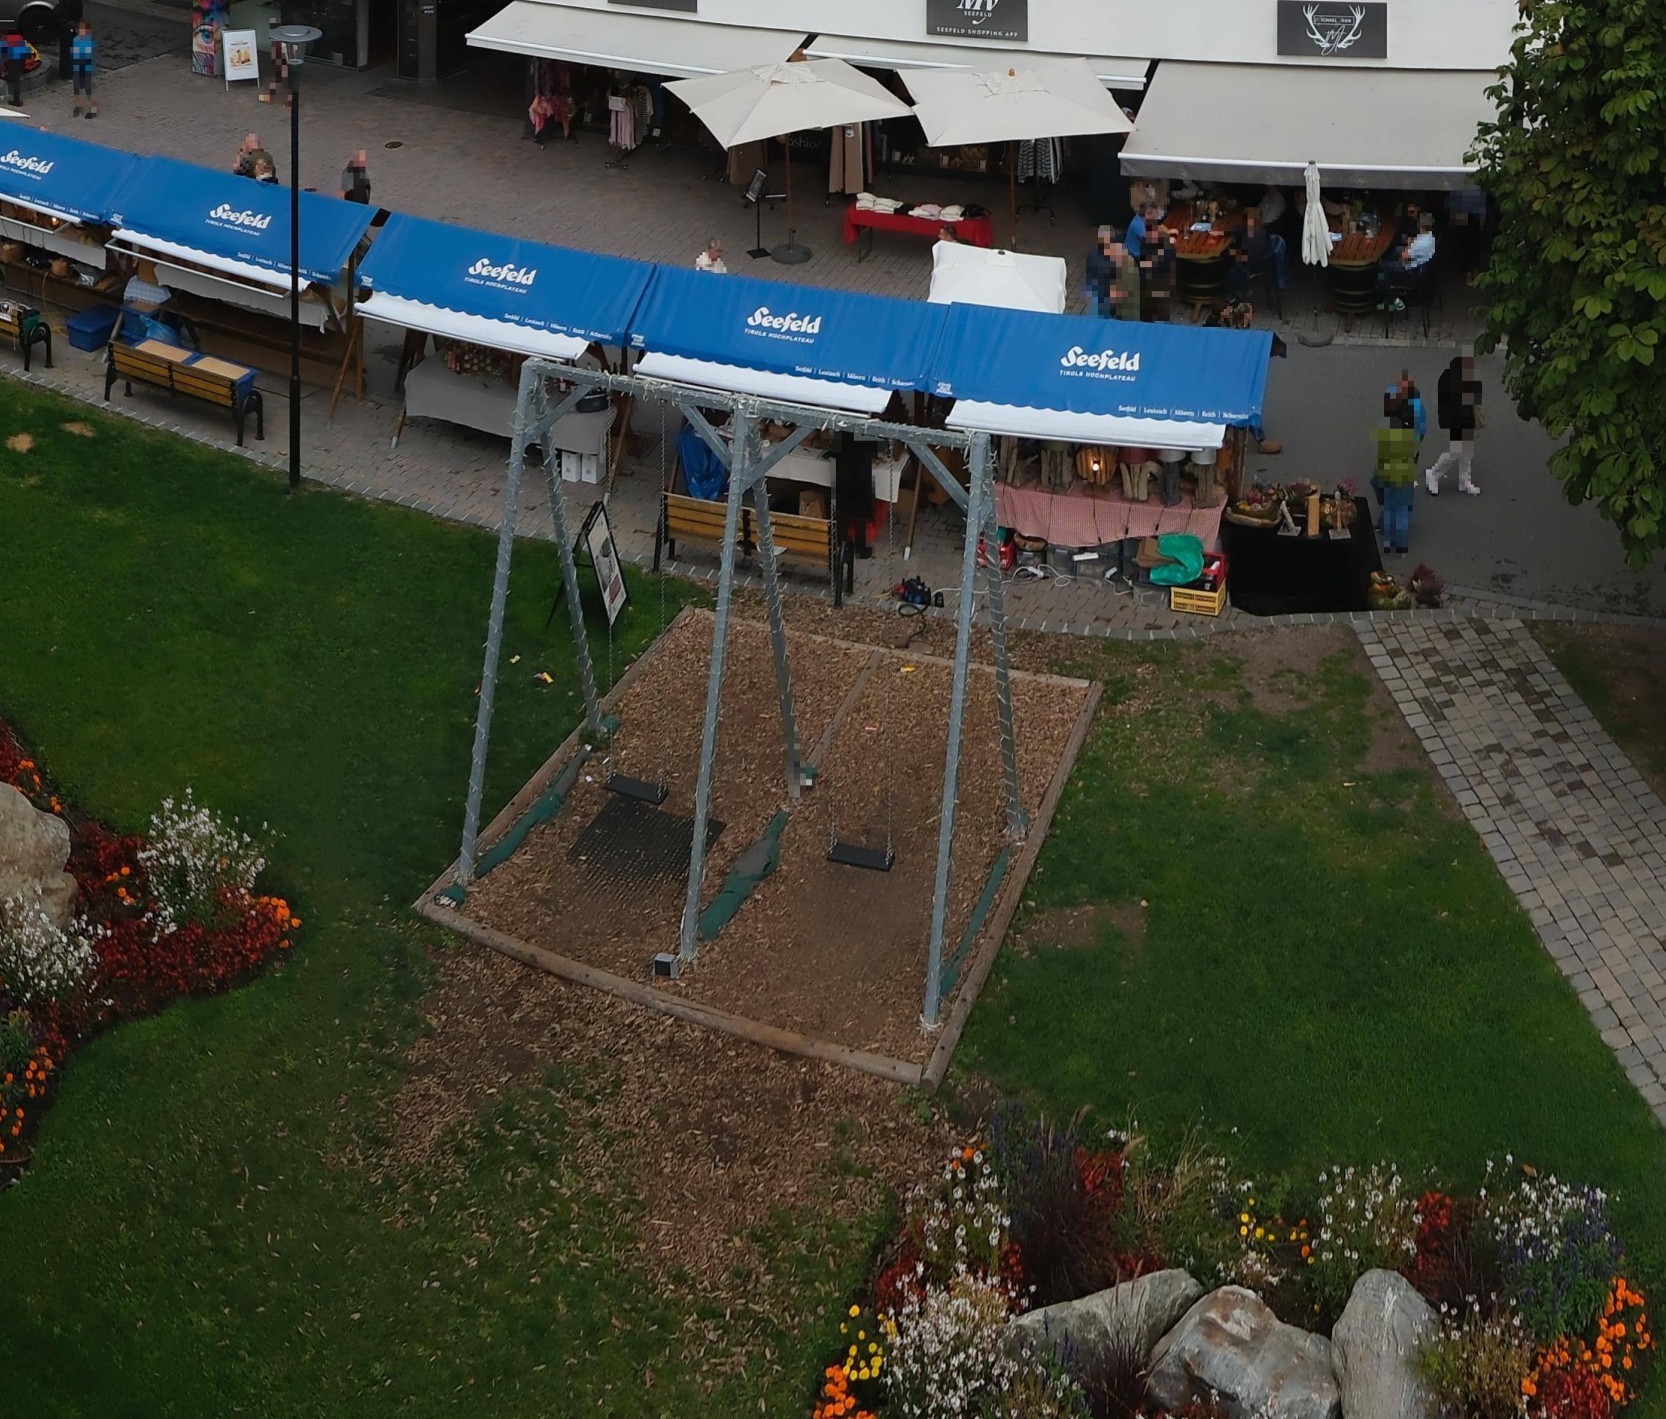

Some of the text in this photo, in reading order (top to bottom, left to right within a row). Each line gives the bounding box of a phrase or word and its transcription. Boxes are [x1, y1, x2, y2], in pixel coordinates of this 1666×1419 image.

[936, 26, 966, 34] SEEFELD
[0, 148, 54, 176] Seefeld
[209, 202, 273, 230] Seefeld
[468, 257, 538, 287] Seefeld
[747, 305, 822, 335] Seefeld
[1060, 345, 1141, 373] Seefeld
[1059, 369, 1136, 382] TIROLS HOCHPLATEAU
